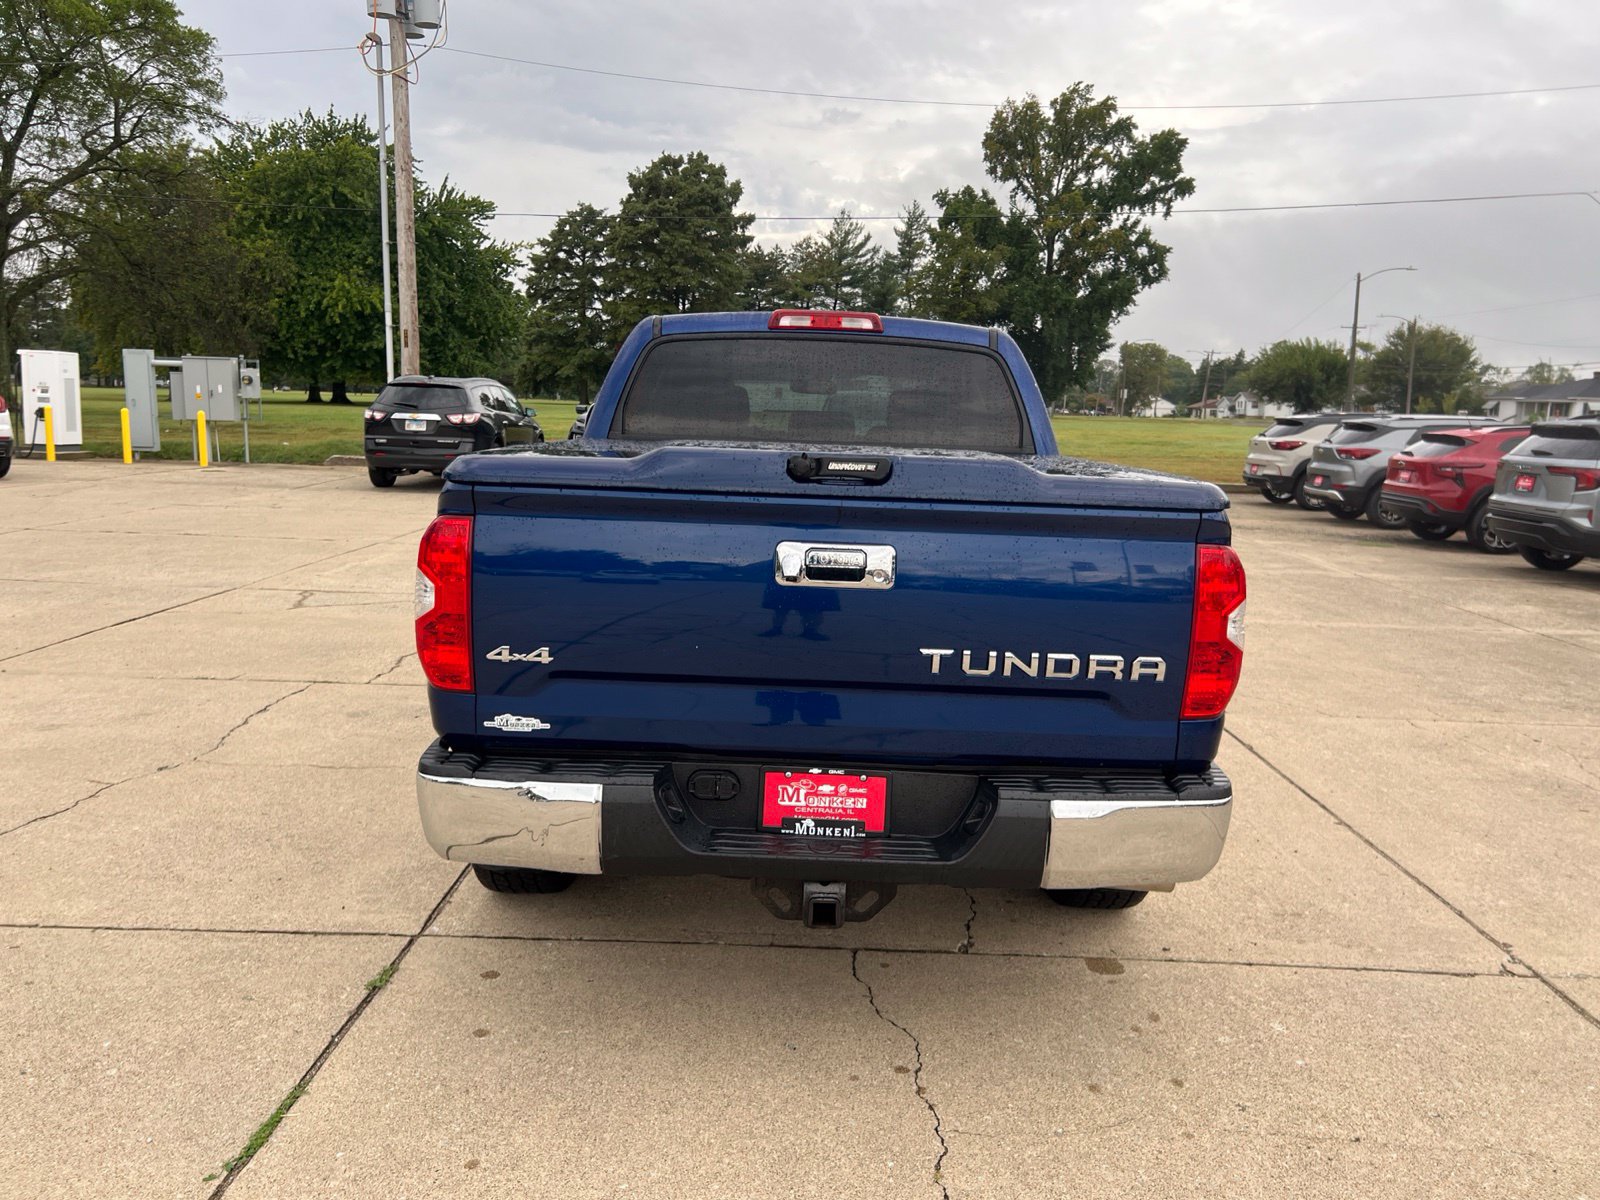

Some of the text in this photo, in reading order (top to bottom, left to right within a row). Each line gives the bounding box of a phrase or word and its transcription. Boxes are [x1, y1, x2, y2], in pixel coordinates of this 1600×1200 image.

[809, 553, 862, 565] TOYOTA
[919, 648, 1167, 682] TUNDRA
[794, 806, 846, 815] CENTRALIA,
